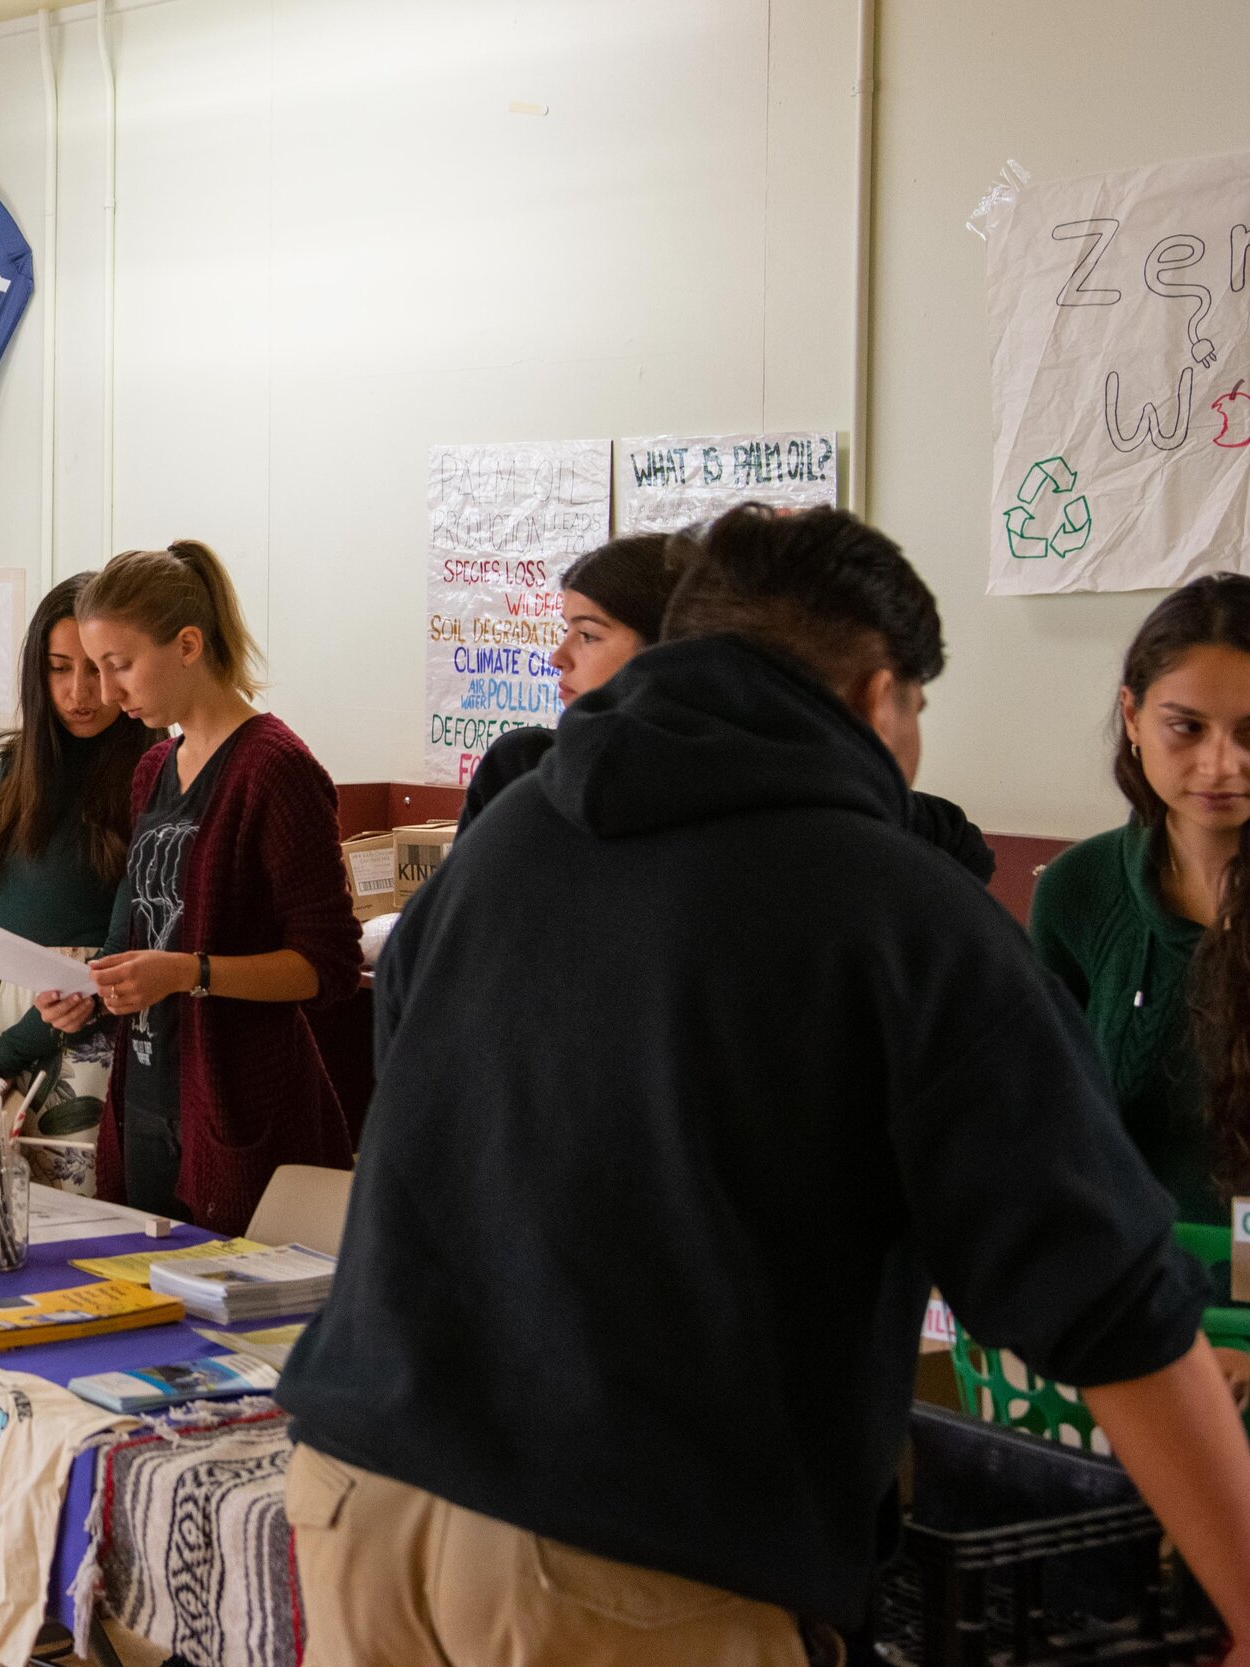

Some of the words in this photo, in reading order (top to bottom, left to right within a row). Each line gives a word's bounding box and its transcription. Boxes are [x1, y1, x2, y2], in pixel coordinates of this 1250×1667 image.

[442, 453, 516, 505] PALM
[533, 460, 604, 505] OIL
[630, 448, 688, 487] WHAT
[703, 446, 723, 485] IS
[733, 441, 783, 486] PALM
[786, 438, 833, 482] OIL?
[432, 510, 547, 553] PRODUCTION
[553, 512, 601, 532] LEADS
[443, 560, 501, 585] SPECIES
[506, 560, 547, 587] LOSS
[461, 693, 487, 710] WATER
[468, 678, 486, 696] AIR
